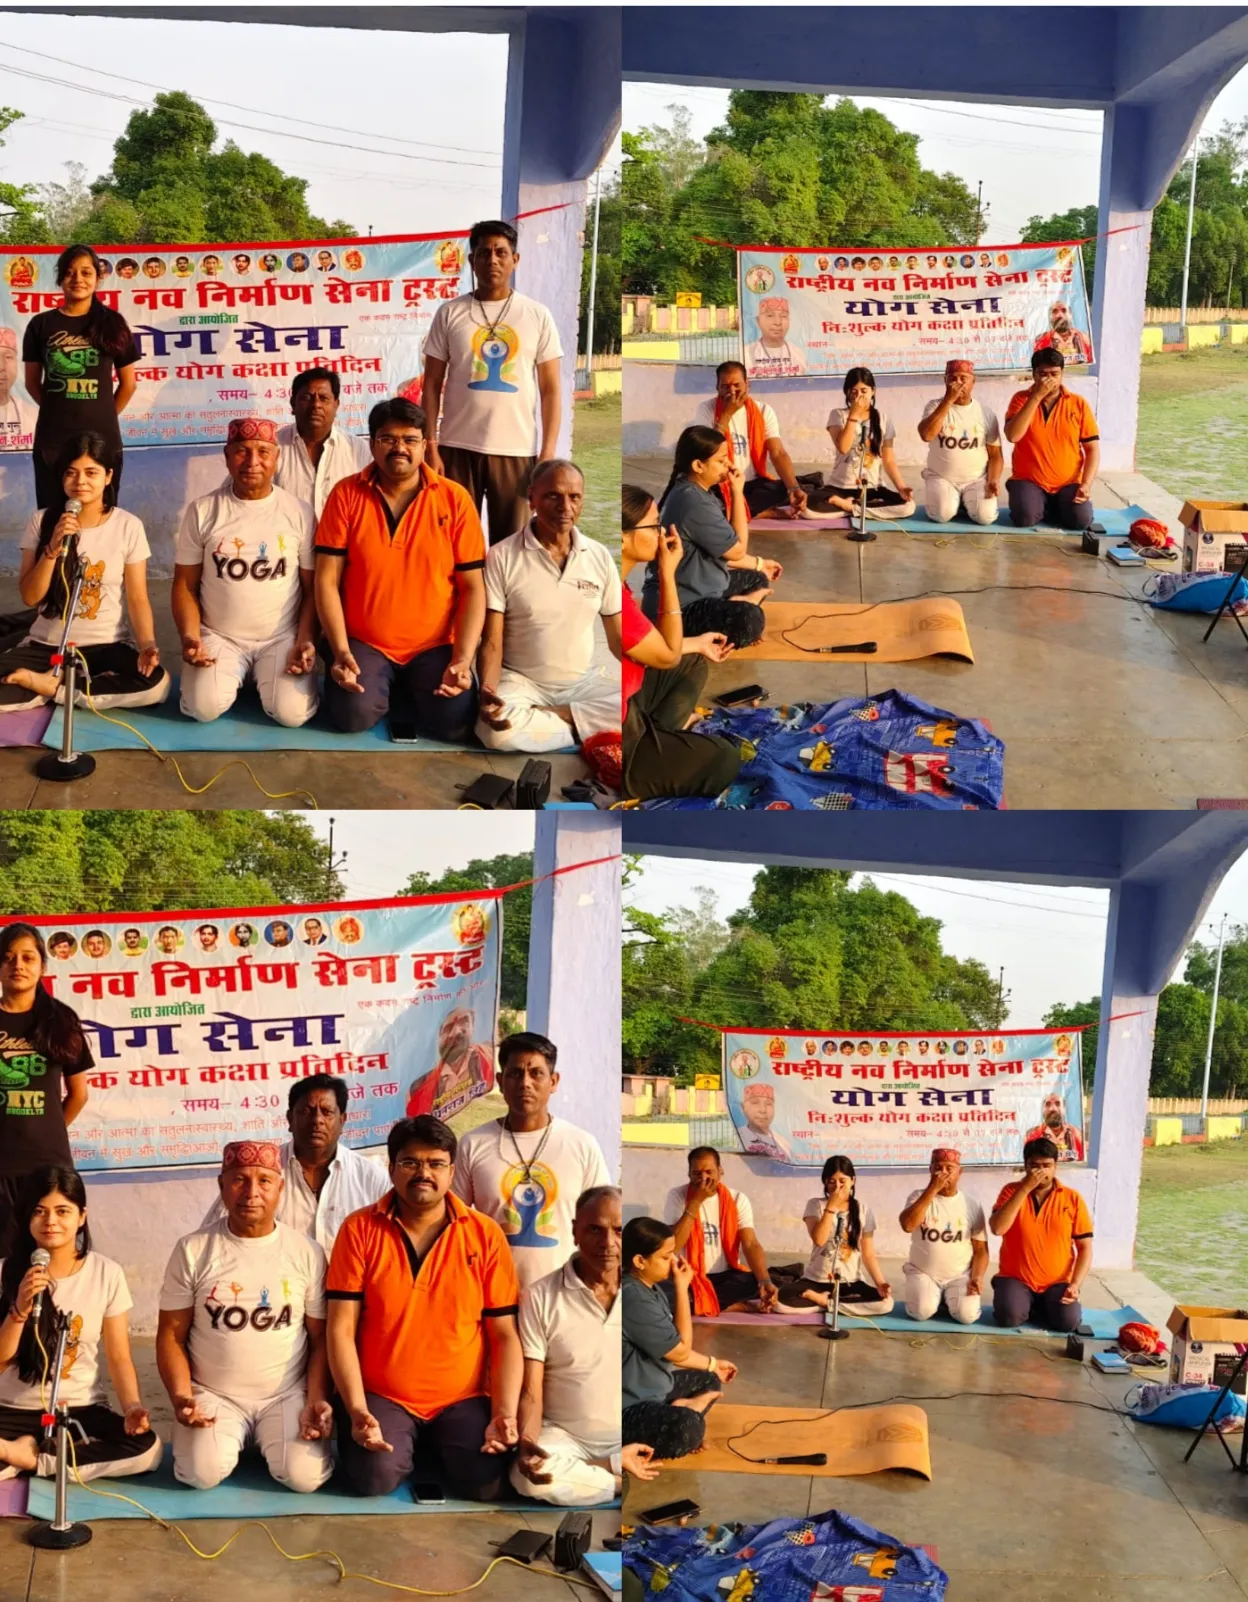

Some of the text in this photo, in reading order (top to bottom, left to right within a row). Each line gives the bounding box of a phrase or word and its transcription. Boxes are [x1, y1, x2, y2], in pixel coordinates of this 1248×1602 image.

[785, 274, 855, 292] राष्ट्रीय
[862, 277, 896, 291] नव
[903, 272, 977, 291] निर्माण
[984, 270, 1029, 287] सेना
[132, 289, 187, 310] नव
[196, 278, 314, 308] निर्माण
[324, 277, 393, 304] सेना
[402, 277, 460, 308] ट्रस्ट
[844, 297, 1002, 316] योग सेना
[198, 313, 239, 325] आयोजित
[892, 321, 922, 332] योग
[928, 319, 963, 331] कक्षा
[233, 321, 348, 353] सेना
[175, 362, 225, 380] योग
[232, 362, 289, 377] कक्षा
[66, 379, 99, 393] NYC
[368, 383, 388, 394] तक
[938, 435, 978, 450] YOGA
[212, 552, 286, 582] YOGA
[69, 972, 139, 1000] नव
[151, 954, 299, 997] निर्माण
[311, 951, 400, 987] सेना
[411, 945, 485, 989] ट्रस्ट
[155, 1001, 205, 1017] आयोजित
[200, 1011, 345, 1052] सेना
[127, 1064, 190, 1088] योग
[198, 1063, 270, 1084] कक्षा
[771, 1060, 844, 1080] राष्ट्रीय
[850, 1064, 886, 1079] नव
[893, 1059, 970, 1079] निर्माण
[977, 1059, 1024, 1077] सेना
[370, 1082, 398, 1097] तक
[830, 1087, 995, 1106] योग सेना
[7, 1090, 45, 1108] NYC
[879, 1111, 911, 1123] योग
[916, 1111, 952, 1123] कक्षा
[958, 1109, 1016, 1123] प्रतिदिन
[920, 1226, 962, 1243] YOGA
[204, 1303, 292, 1332] YOGA
